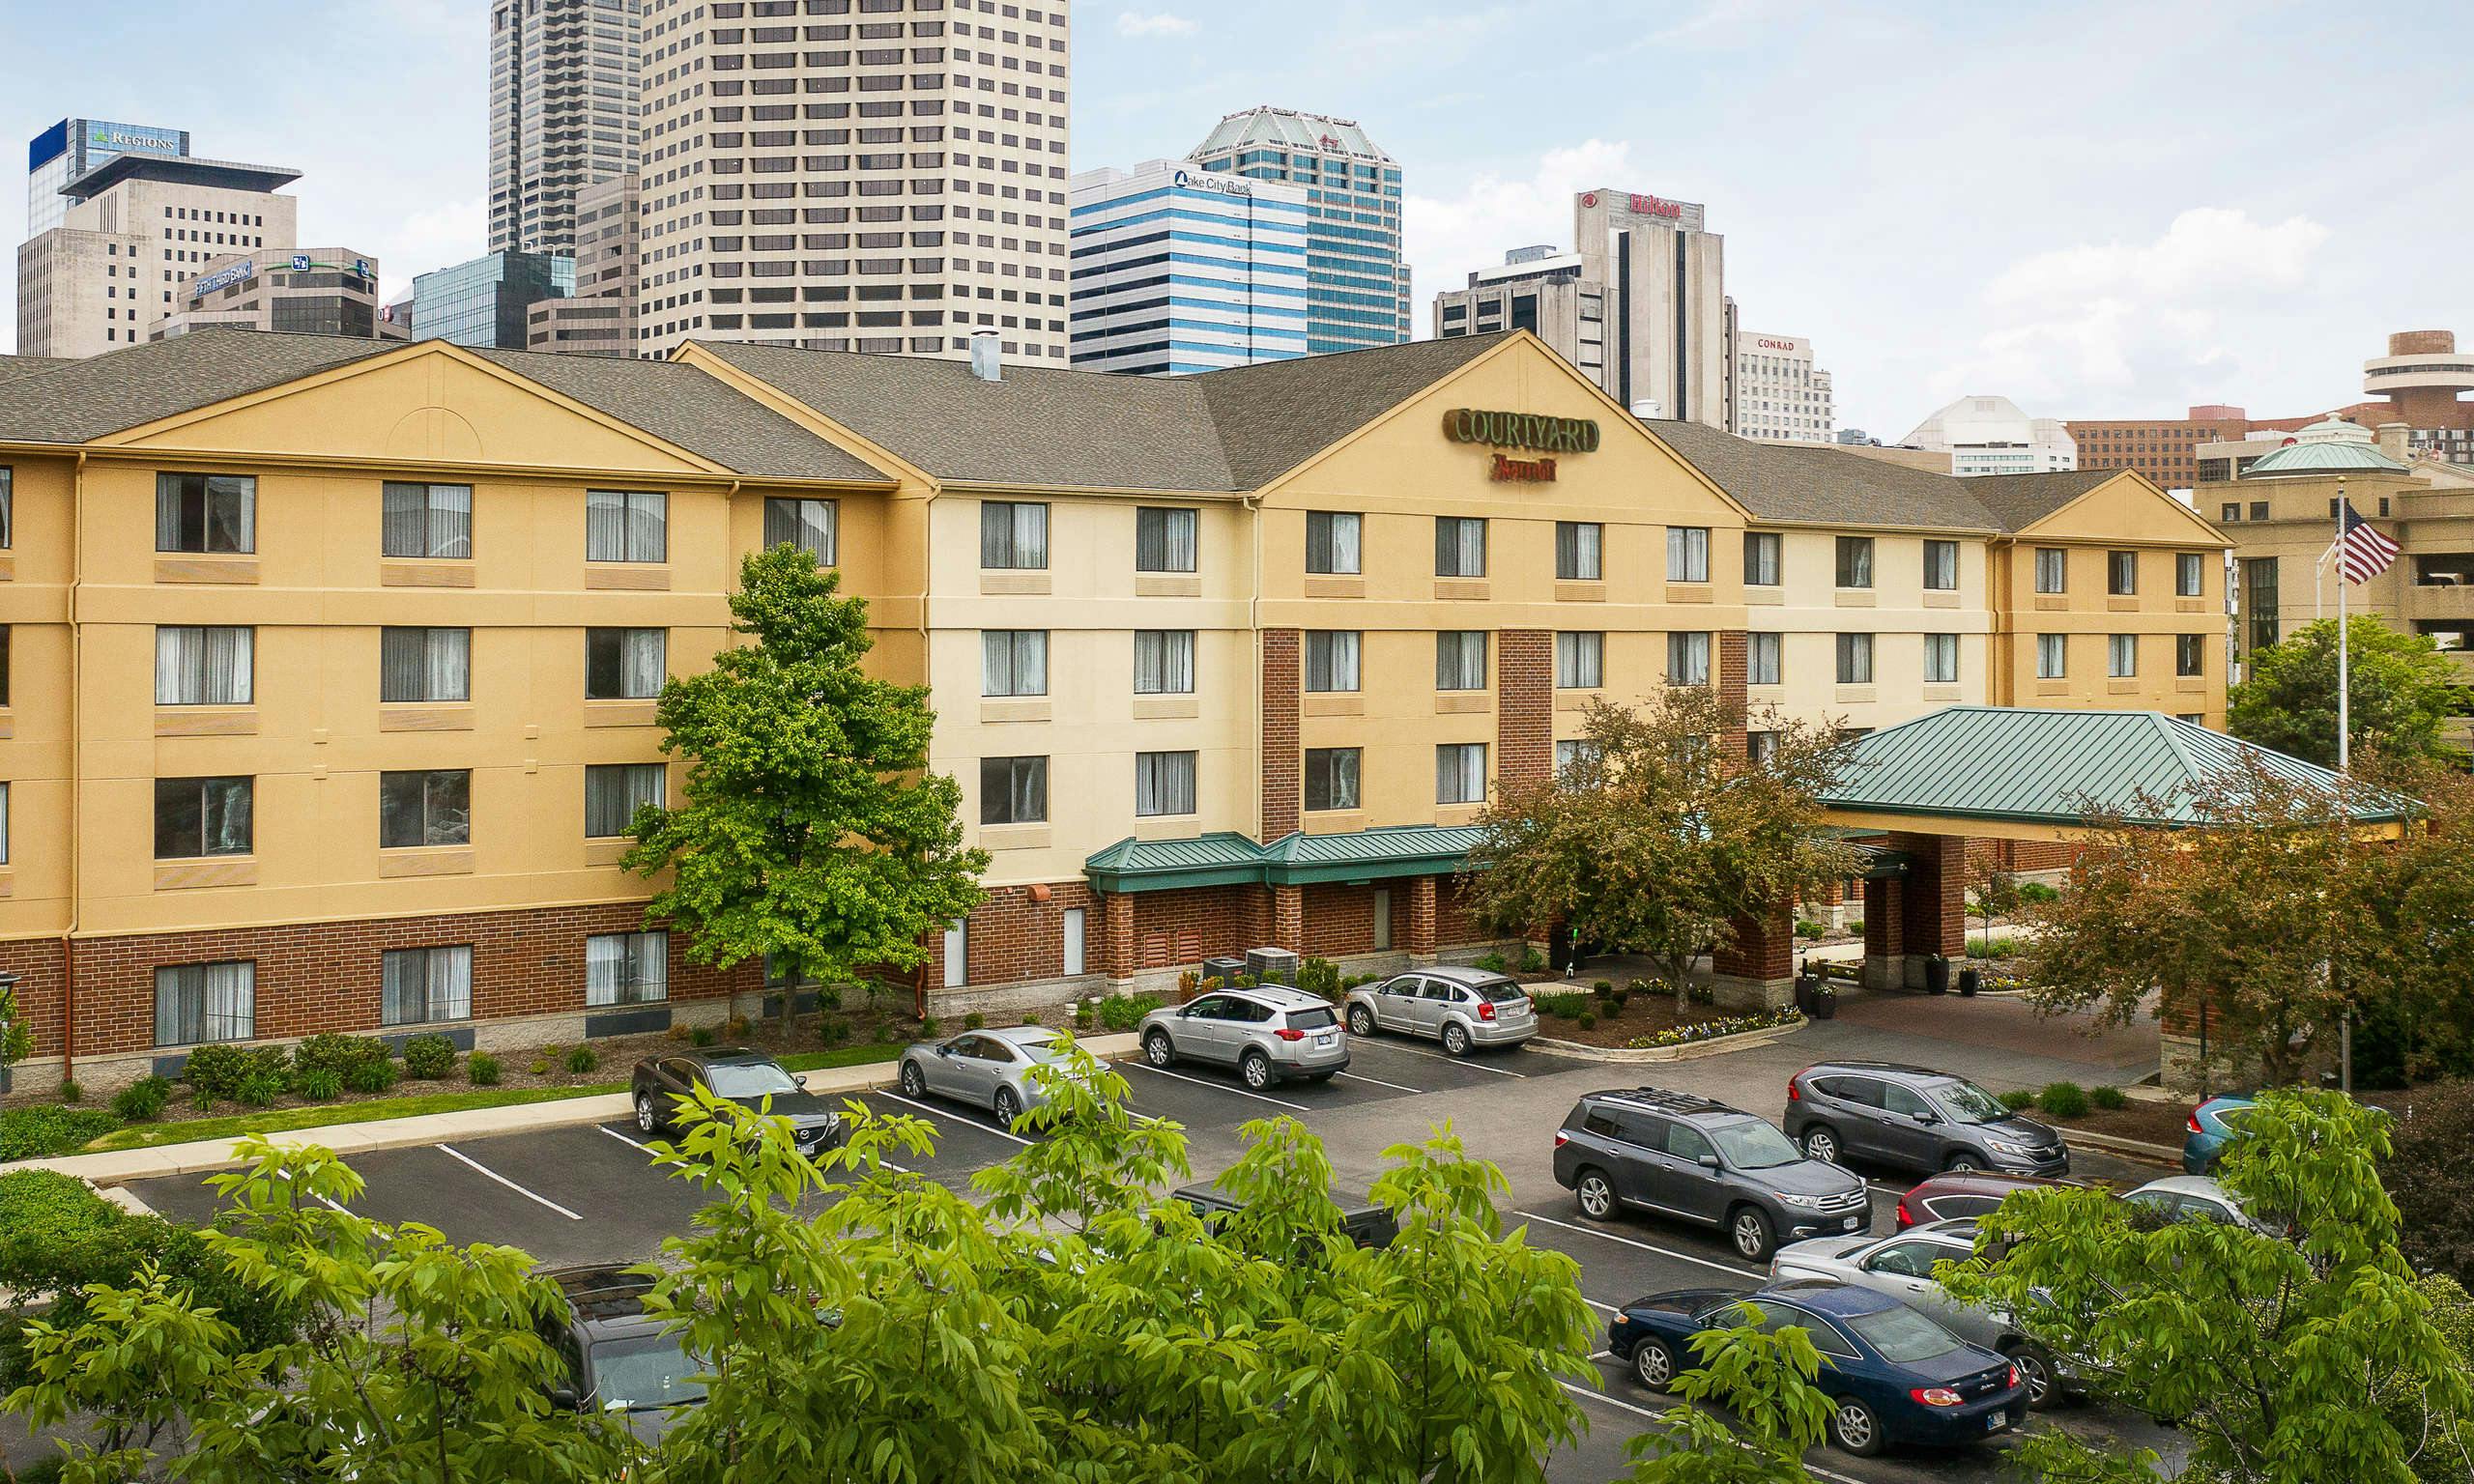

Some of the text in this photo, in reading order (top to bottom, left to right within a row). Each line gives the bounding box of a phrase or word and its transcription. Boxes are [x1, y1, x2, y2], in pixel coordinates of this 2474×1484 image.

[111, 131, 174, 150] REGIONS
[1206, 178, 1226, 193] City
[1227, 180, 1252, 194] Bank
[1630, 193, 1681, 217] Hilton
[230, 260, 249, 281] BANK
[1758, 338, 1795, 351] CONRAD
[1453, 408, 1599, 453] COURTYARD
